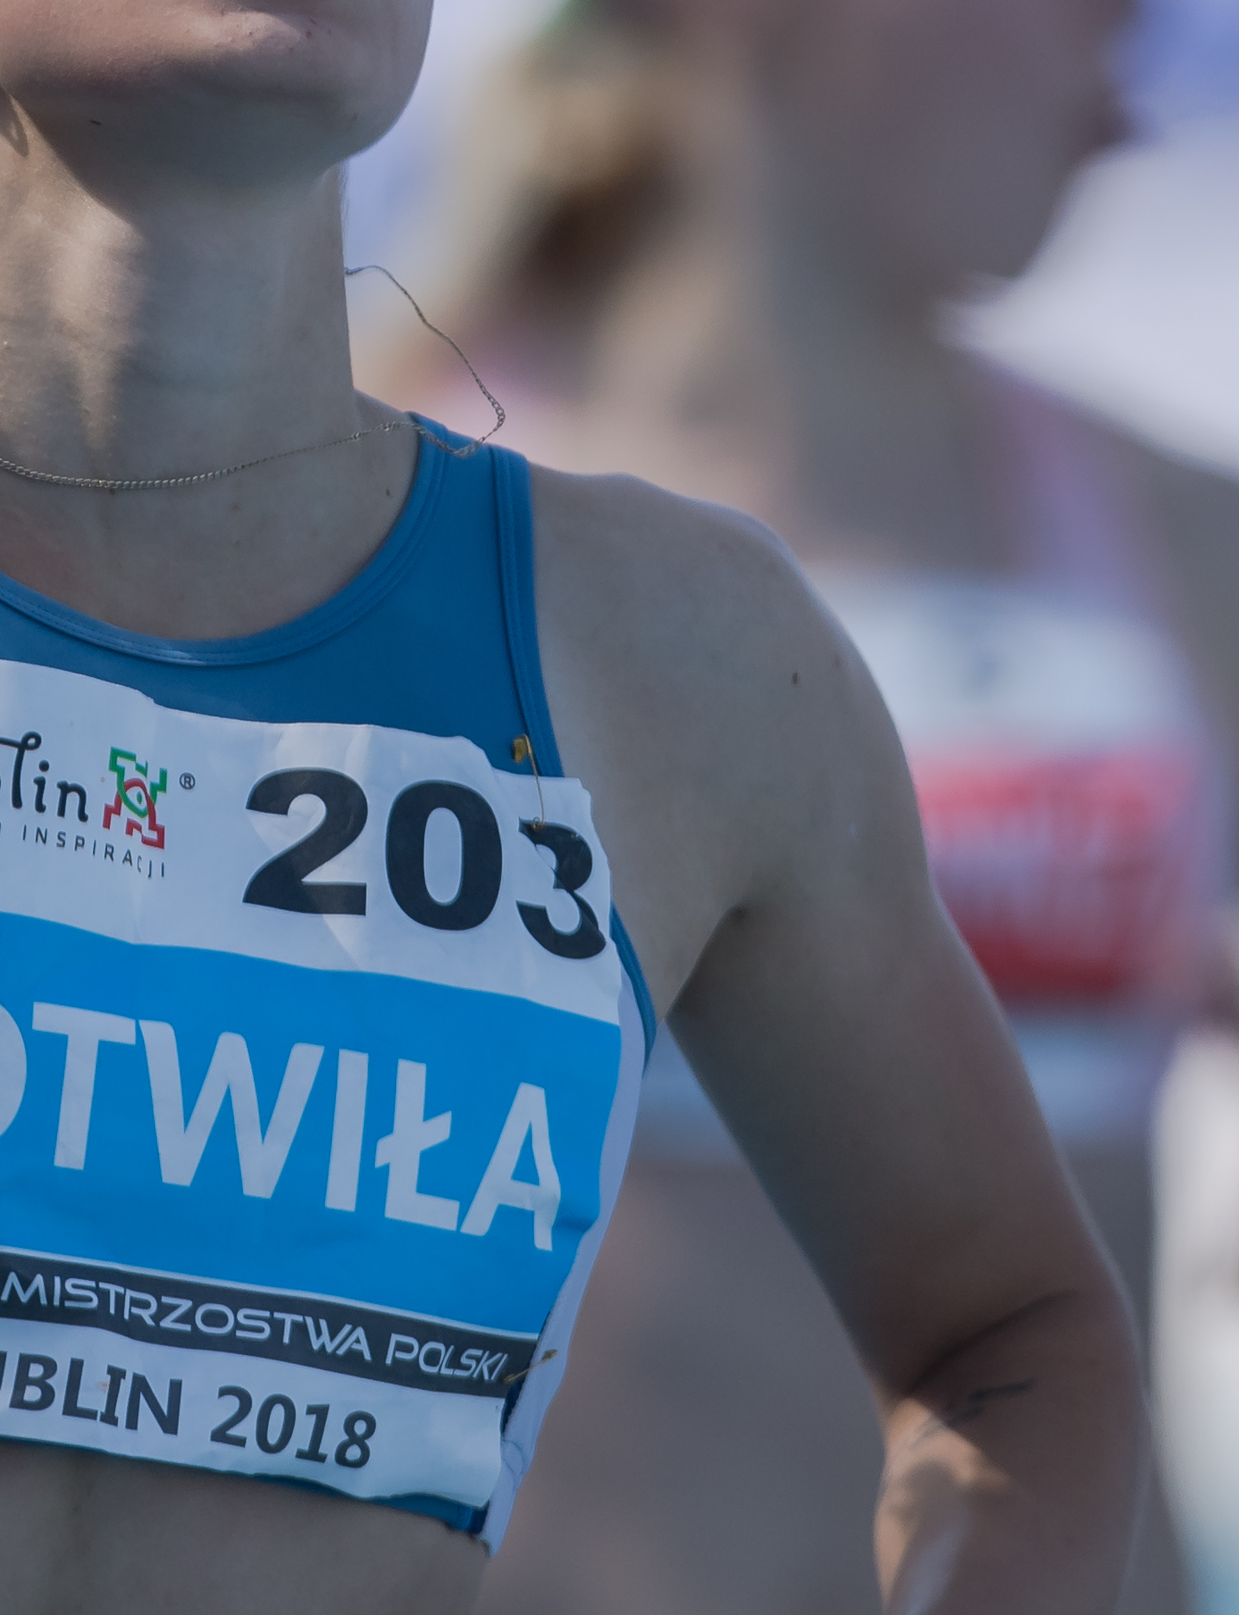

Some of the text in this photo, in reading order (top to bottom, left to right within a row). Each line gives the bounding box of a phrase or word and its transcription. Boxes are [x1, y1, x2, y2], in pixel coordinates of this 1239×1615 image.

[242, 767, 607, 959] 203
[0, 1272, 371, 1363] MISTRZOSTWA
[385, 1332, 509, 1382] POLSKI
[210, 1384, 378, 1469] 2018
